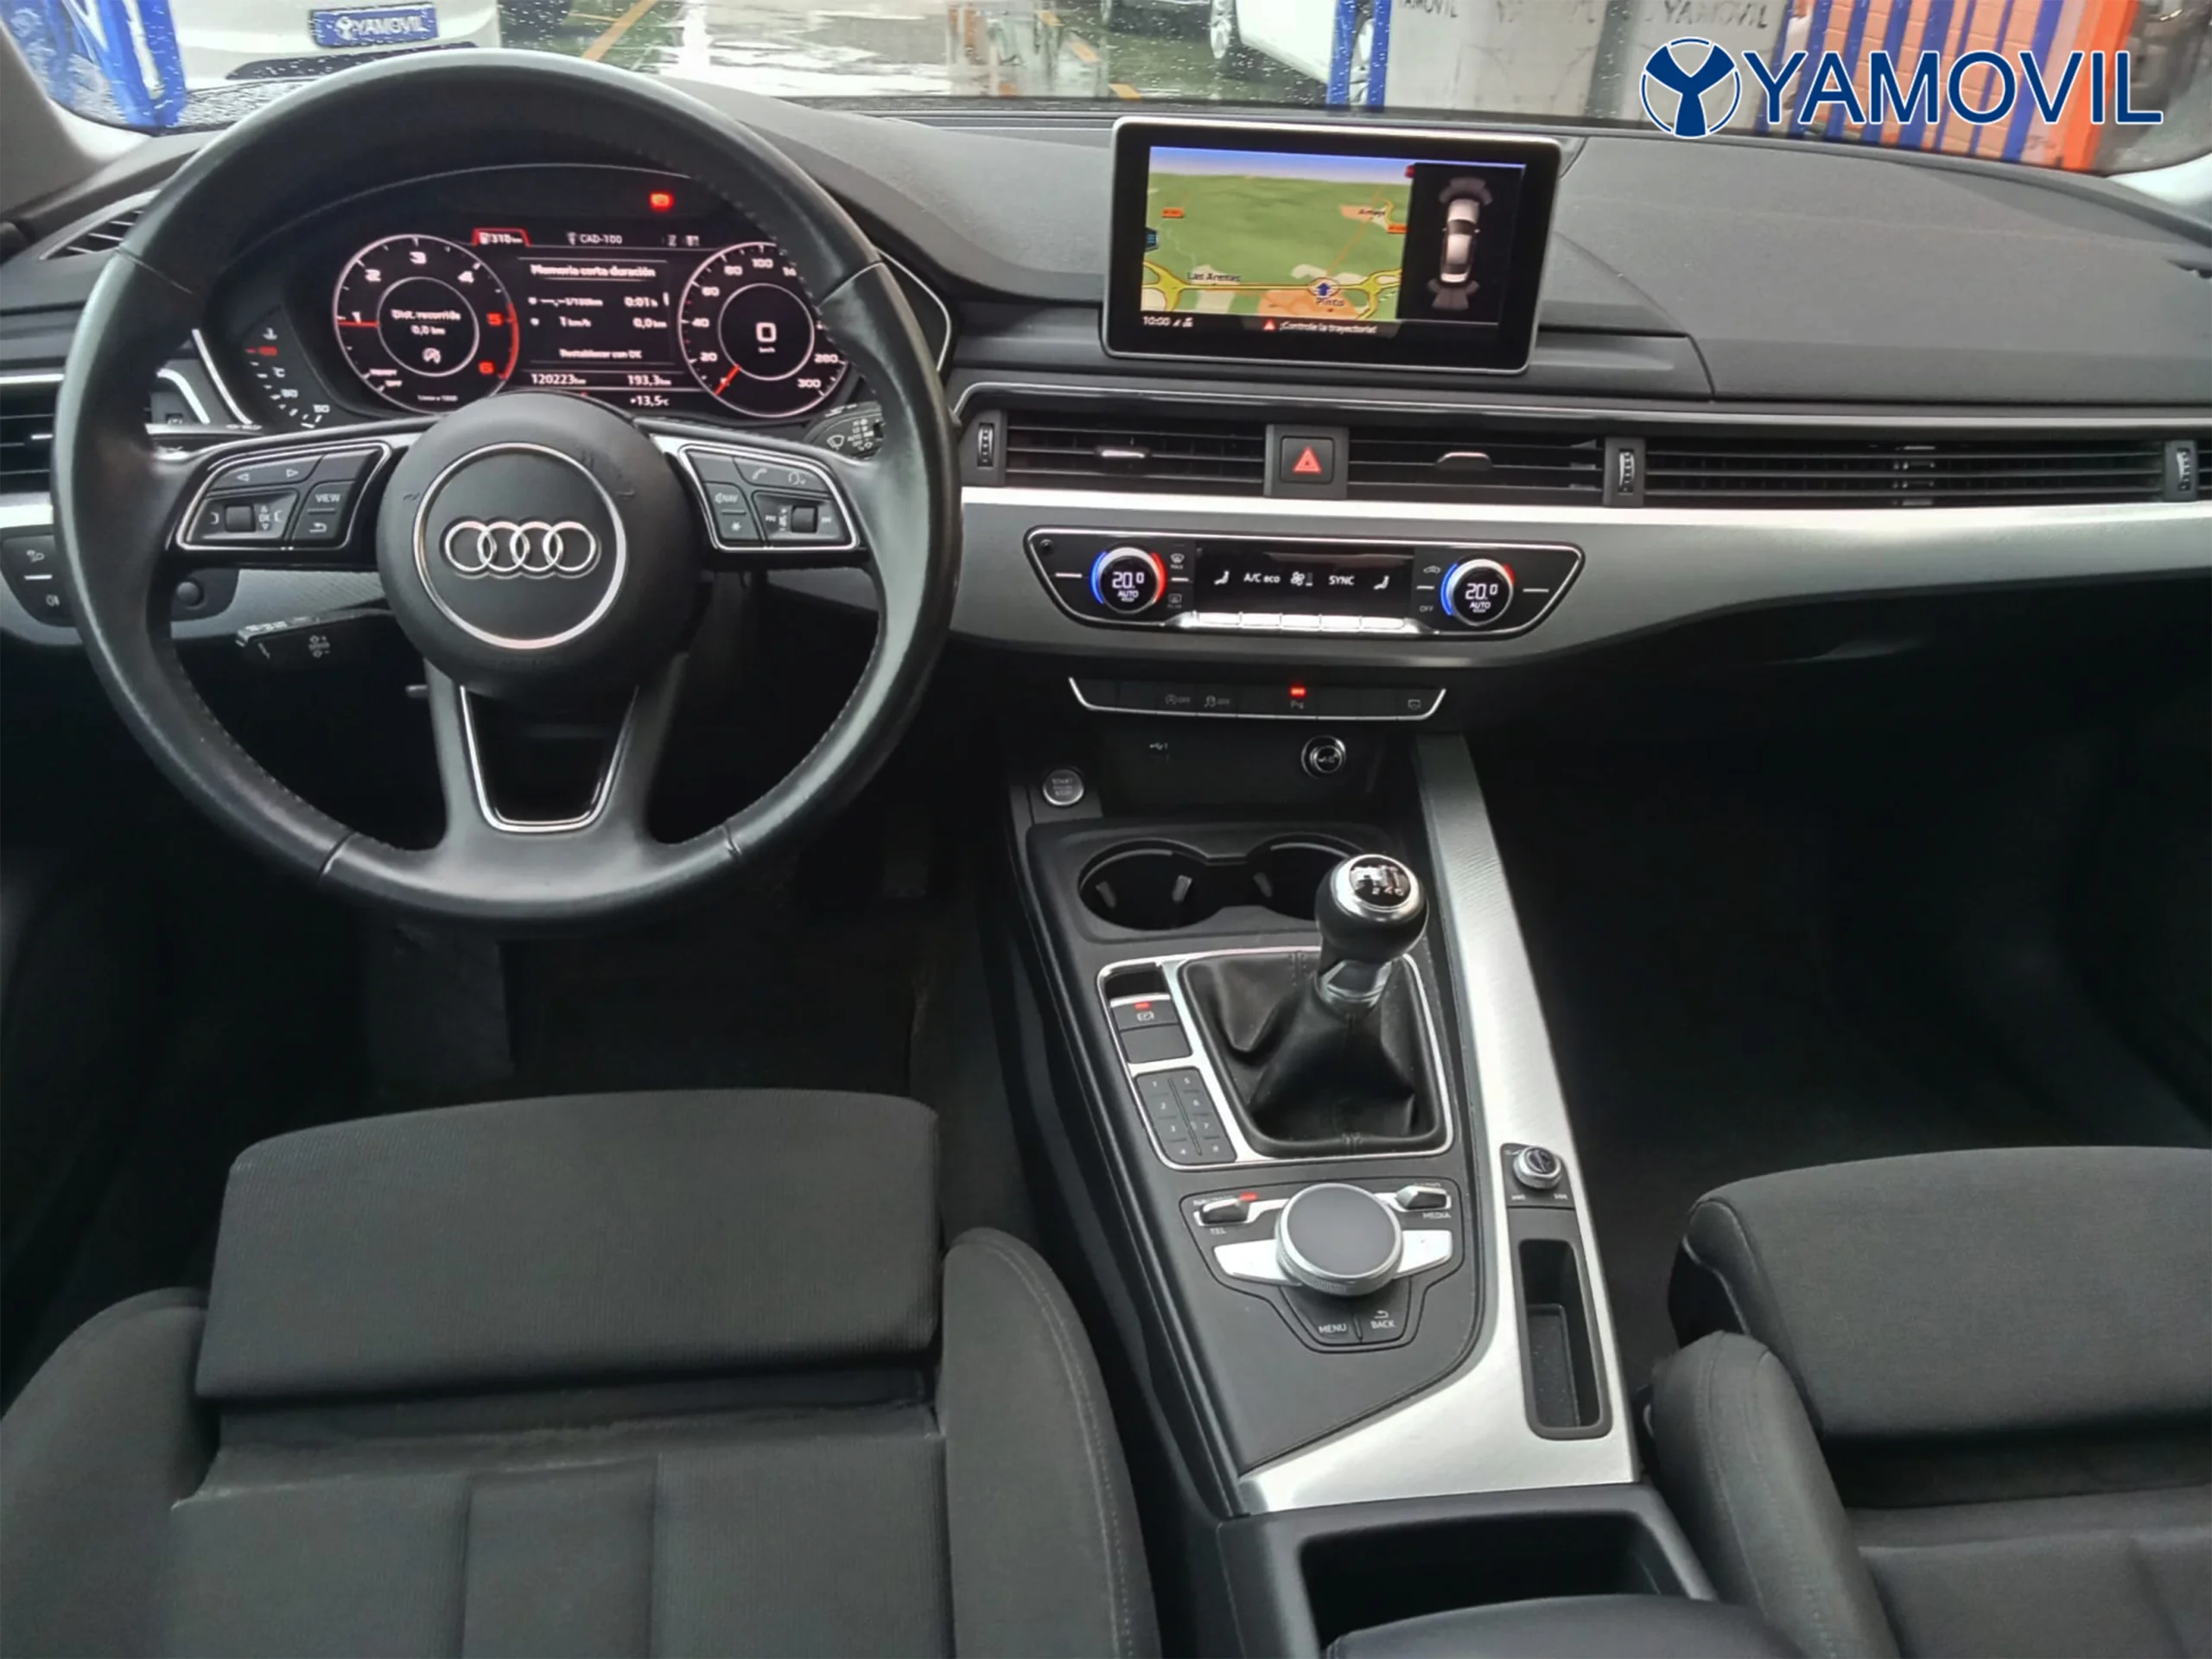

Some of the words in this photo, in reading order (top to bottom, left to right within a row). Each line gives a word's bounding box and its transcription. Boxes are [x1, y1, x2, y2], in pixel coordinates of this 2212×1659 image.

[756, 322, 777, 343] 0
[315, 493, 341, 503] VIEW
[1328, 574, 1355, 586] SYNC
[1117, 589, 1140, 599] AUTO
[1469, 601, 1491, 610] AUTO
[1318, 1323, 1347, 1333] MENU
[1370, 1319, 1395, 1330] BACK
